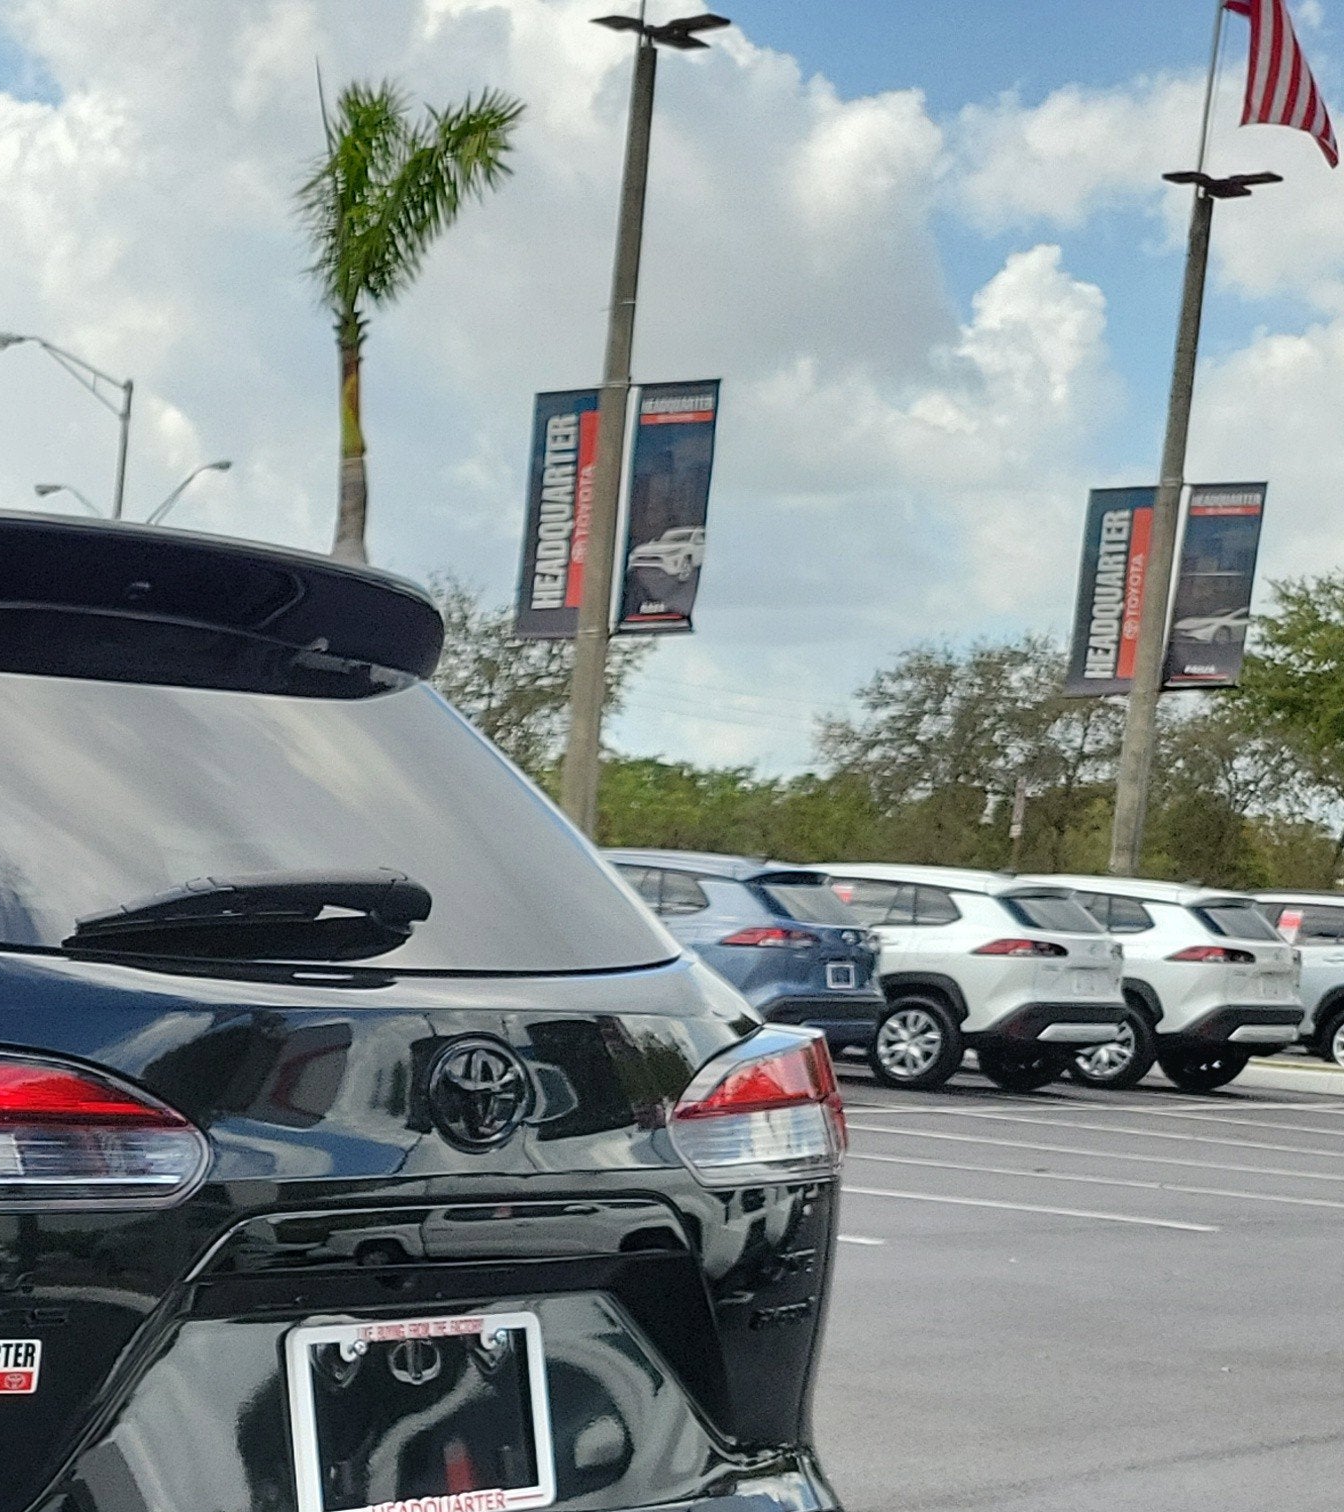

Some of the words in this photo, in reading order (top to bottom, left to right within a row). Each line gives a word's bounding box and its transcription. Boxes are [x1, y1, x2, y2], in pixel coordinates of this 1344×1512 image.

[531, 413, 579, 609] HEADQUARTER
[1084, 509, 1131, 678] HEADQUARTER
[1126, 553, 1145, 618] TOYOTA
